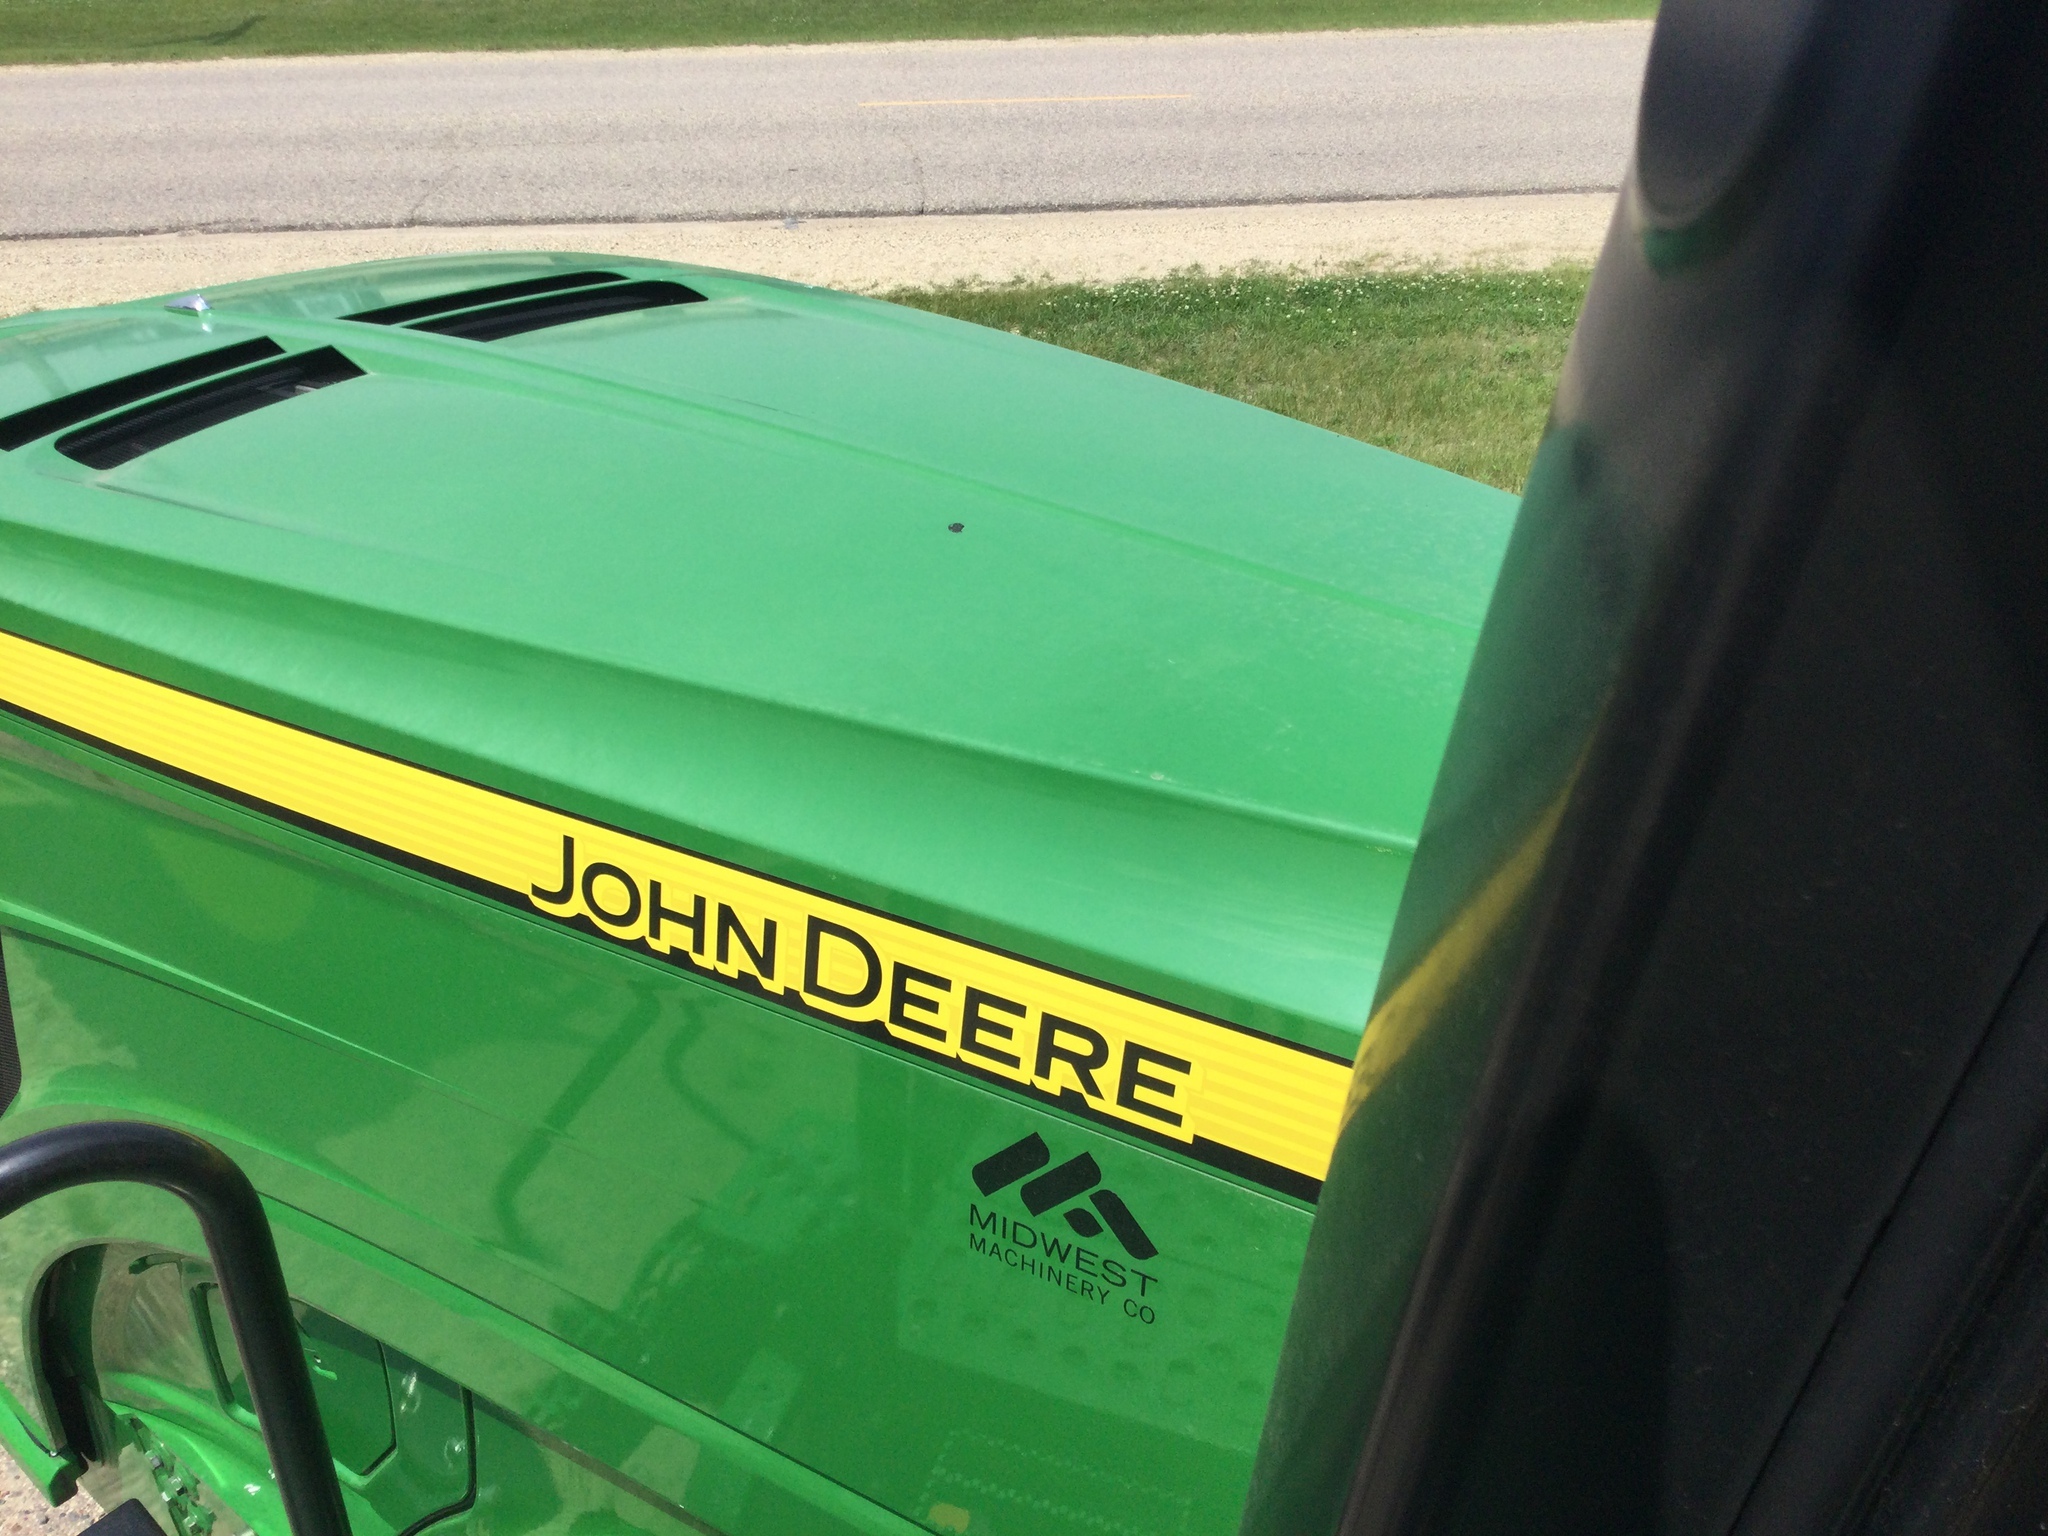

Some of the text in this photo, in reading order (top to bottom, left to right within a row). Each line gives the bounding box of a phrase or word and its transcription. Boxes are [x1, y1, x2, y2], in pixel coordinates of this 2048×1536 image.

[530, 835, 1193, 1128] JOHN DEERE
[969, 1203, 1159, 1297] MIDWEST
[969, 1232, 1156, 1325] MACHINERY CO
